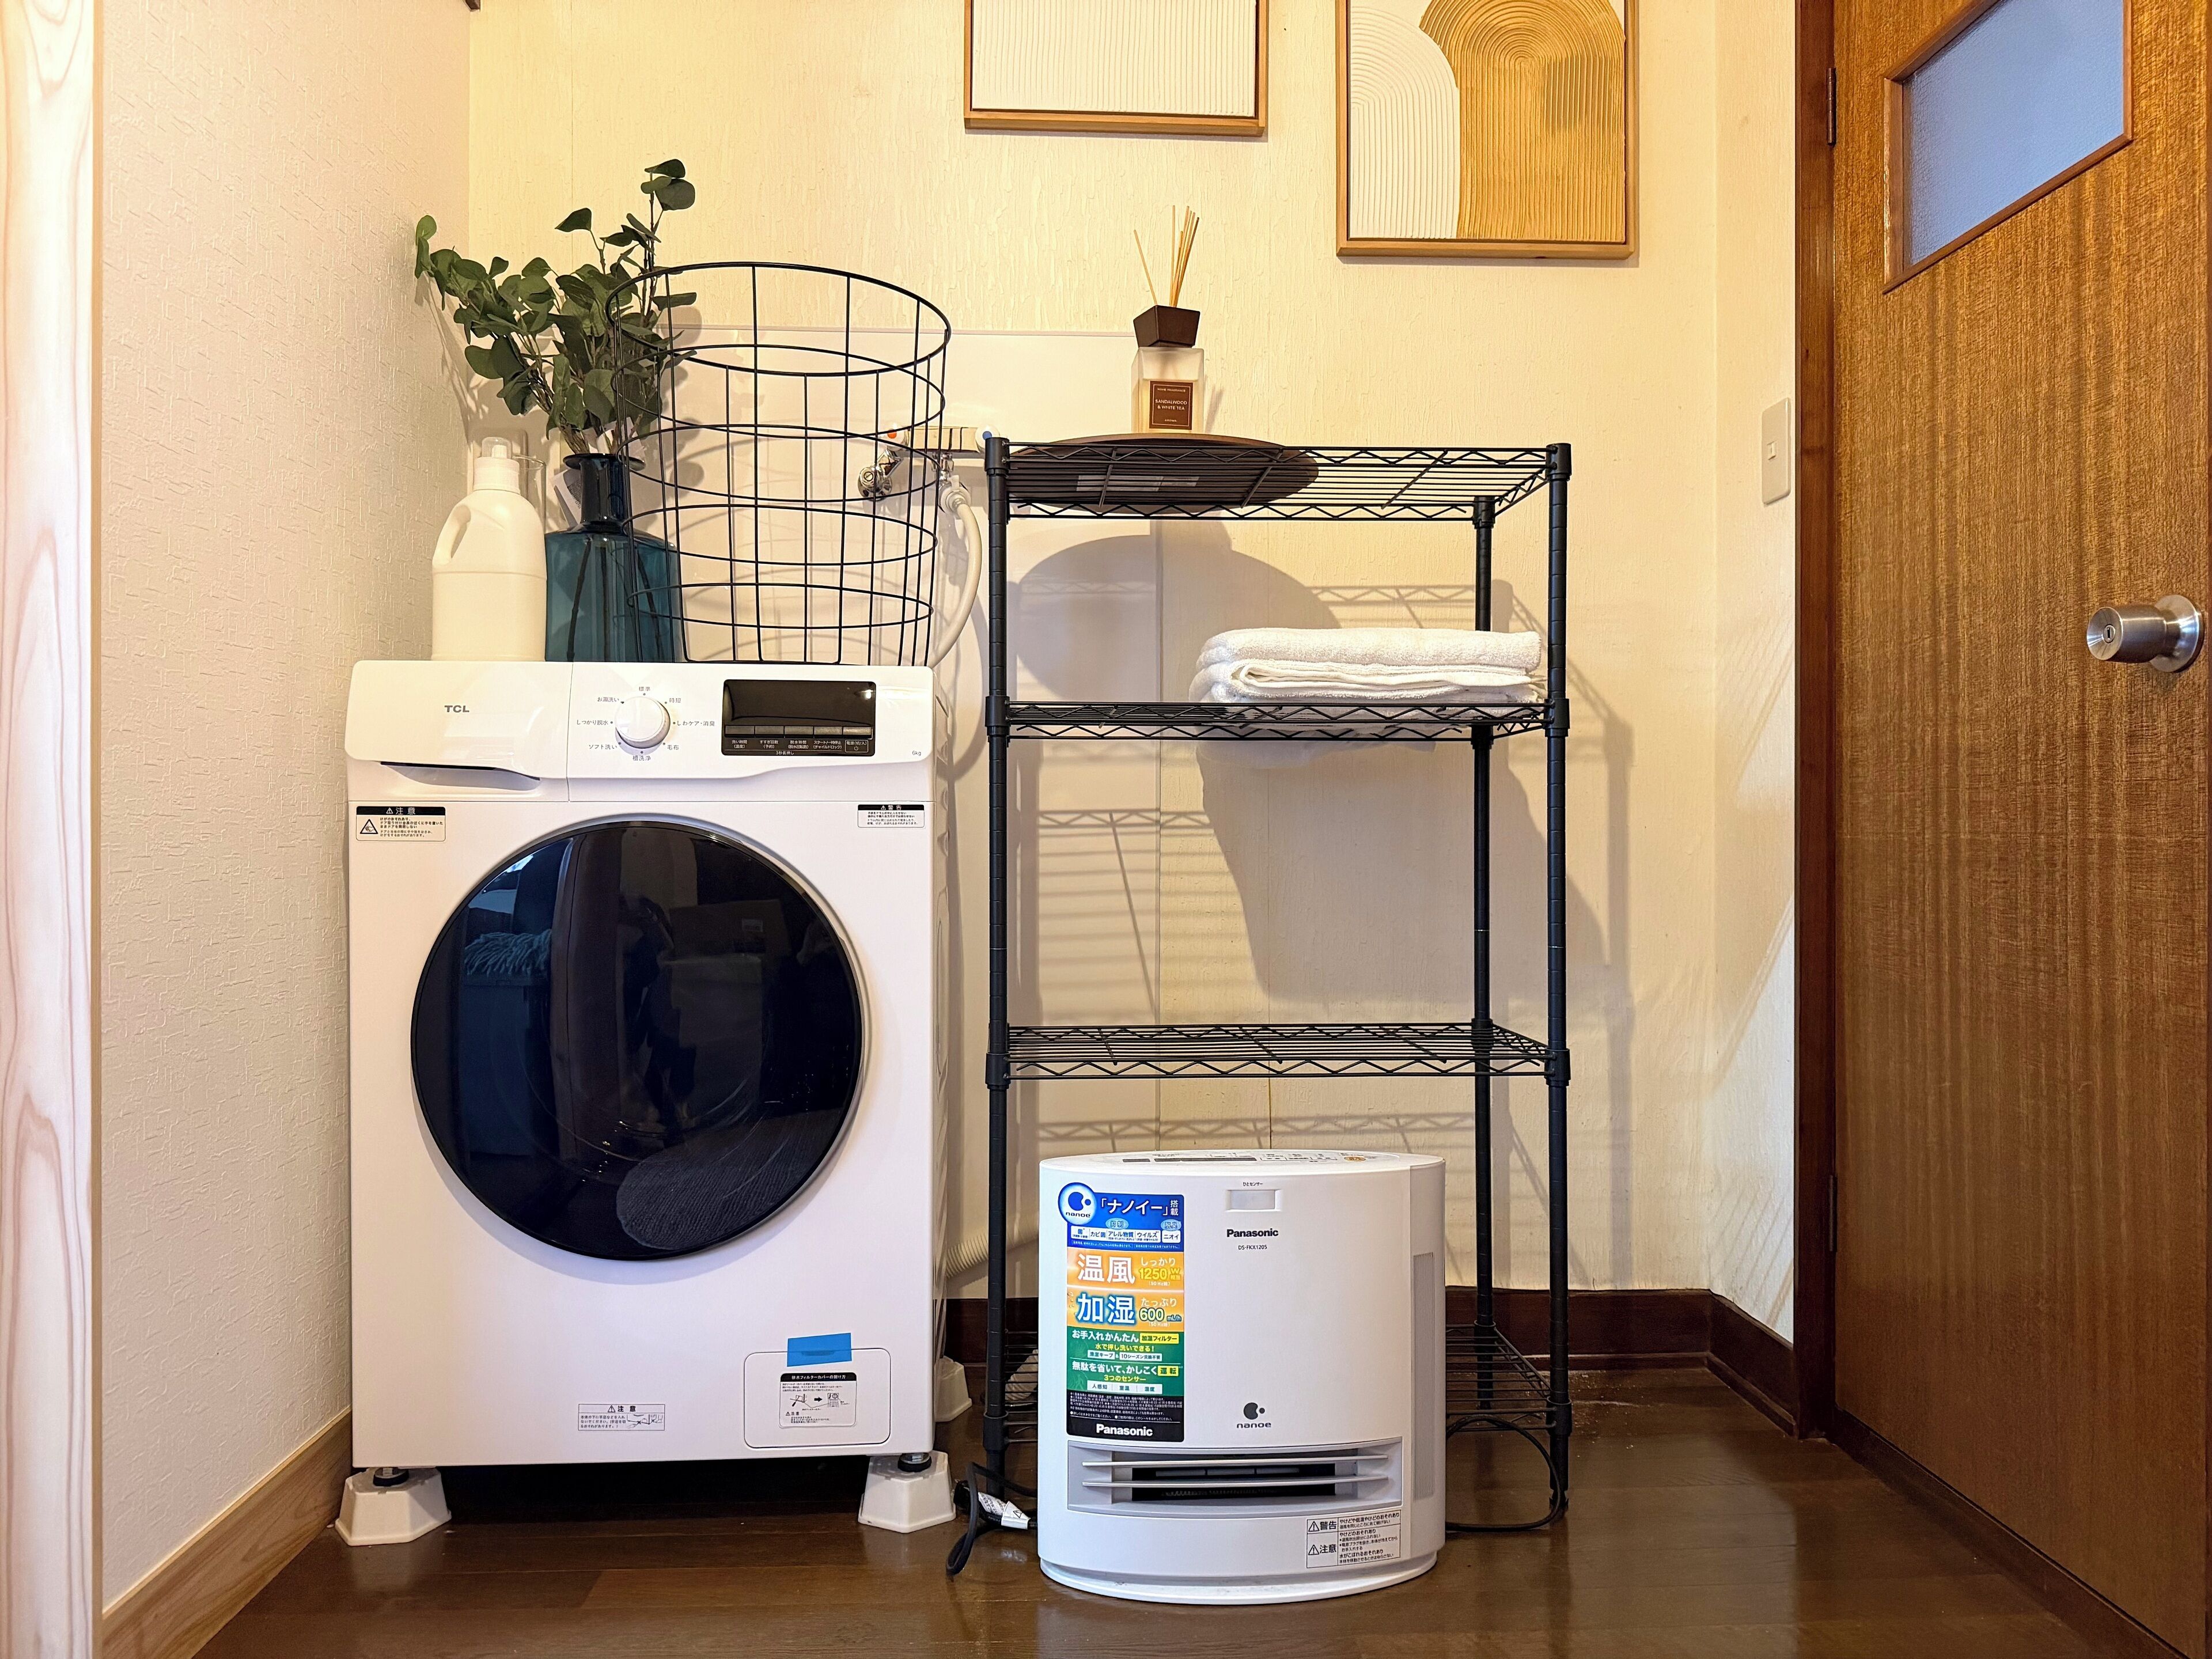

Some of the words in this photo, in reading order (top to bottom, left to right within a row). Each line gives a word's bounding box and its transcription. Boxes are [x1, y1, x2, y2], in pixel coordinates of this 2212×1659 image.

[1101, 1198, 1168, 1216] 「ナノイー」
[1226, 1228, 1279, 1237] Panasonic
[1141, 1257, 1176, 1266] しっかり
[1077, 1253, 1135, 1284] 温風
[1139, 1268, 1168, 1280] 1250
[1141, 1297, 1177, 1307] たっぷり
[1077, 1293, 1135, 1324] 加湿
[1139, 1307, 1165, 1321] 600
[1072, 1330, 1139, 1343] お手入れかんたん
[1096, 1423, 1153, 1436] Panasonic
[1320, 1521, 1337, 1531] 警告
[1320, 1544, 1337, 1554] 注意
